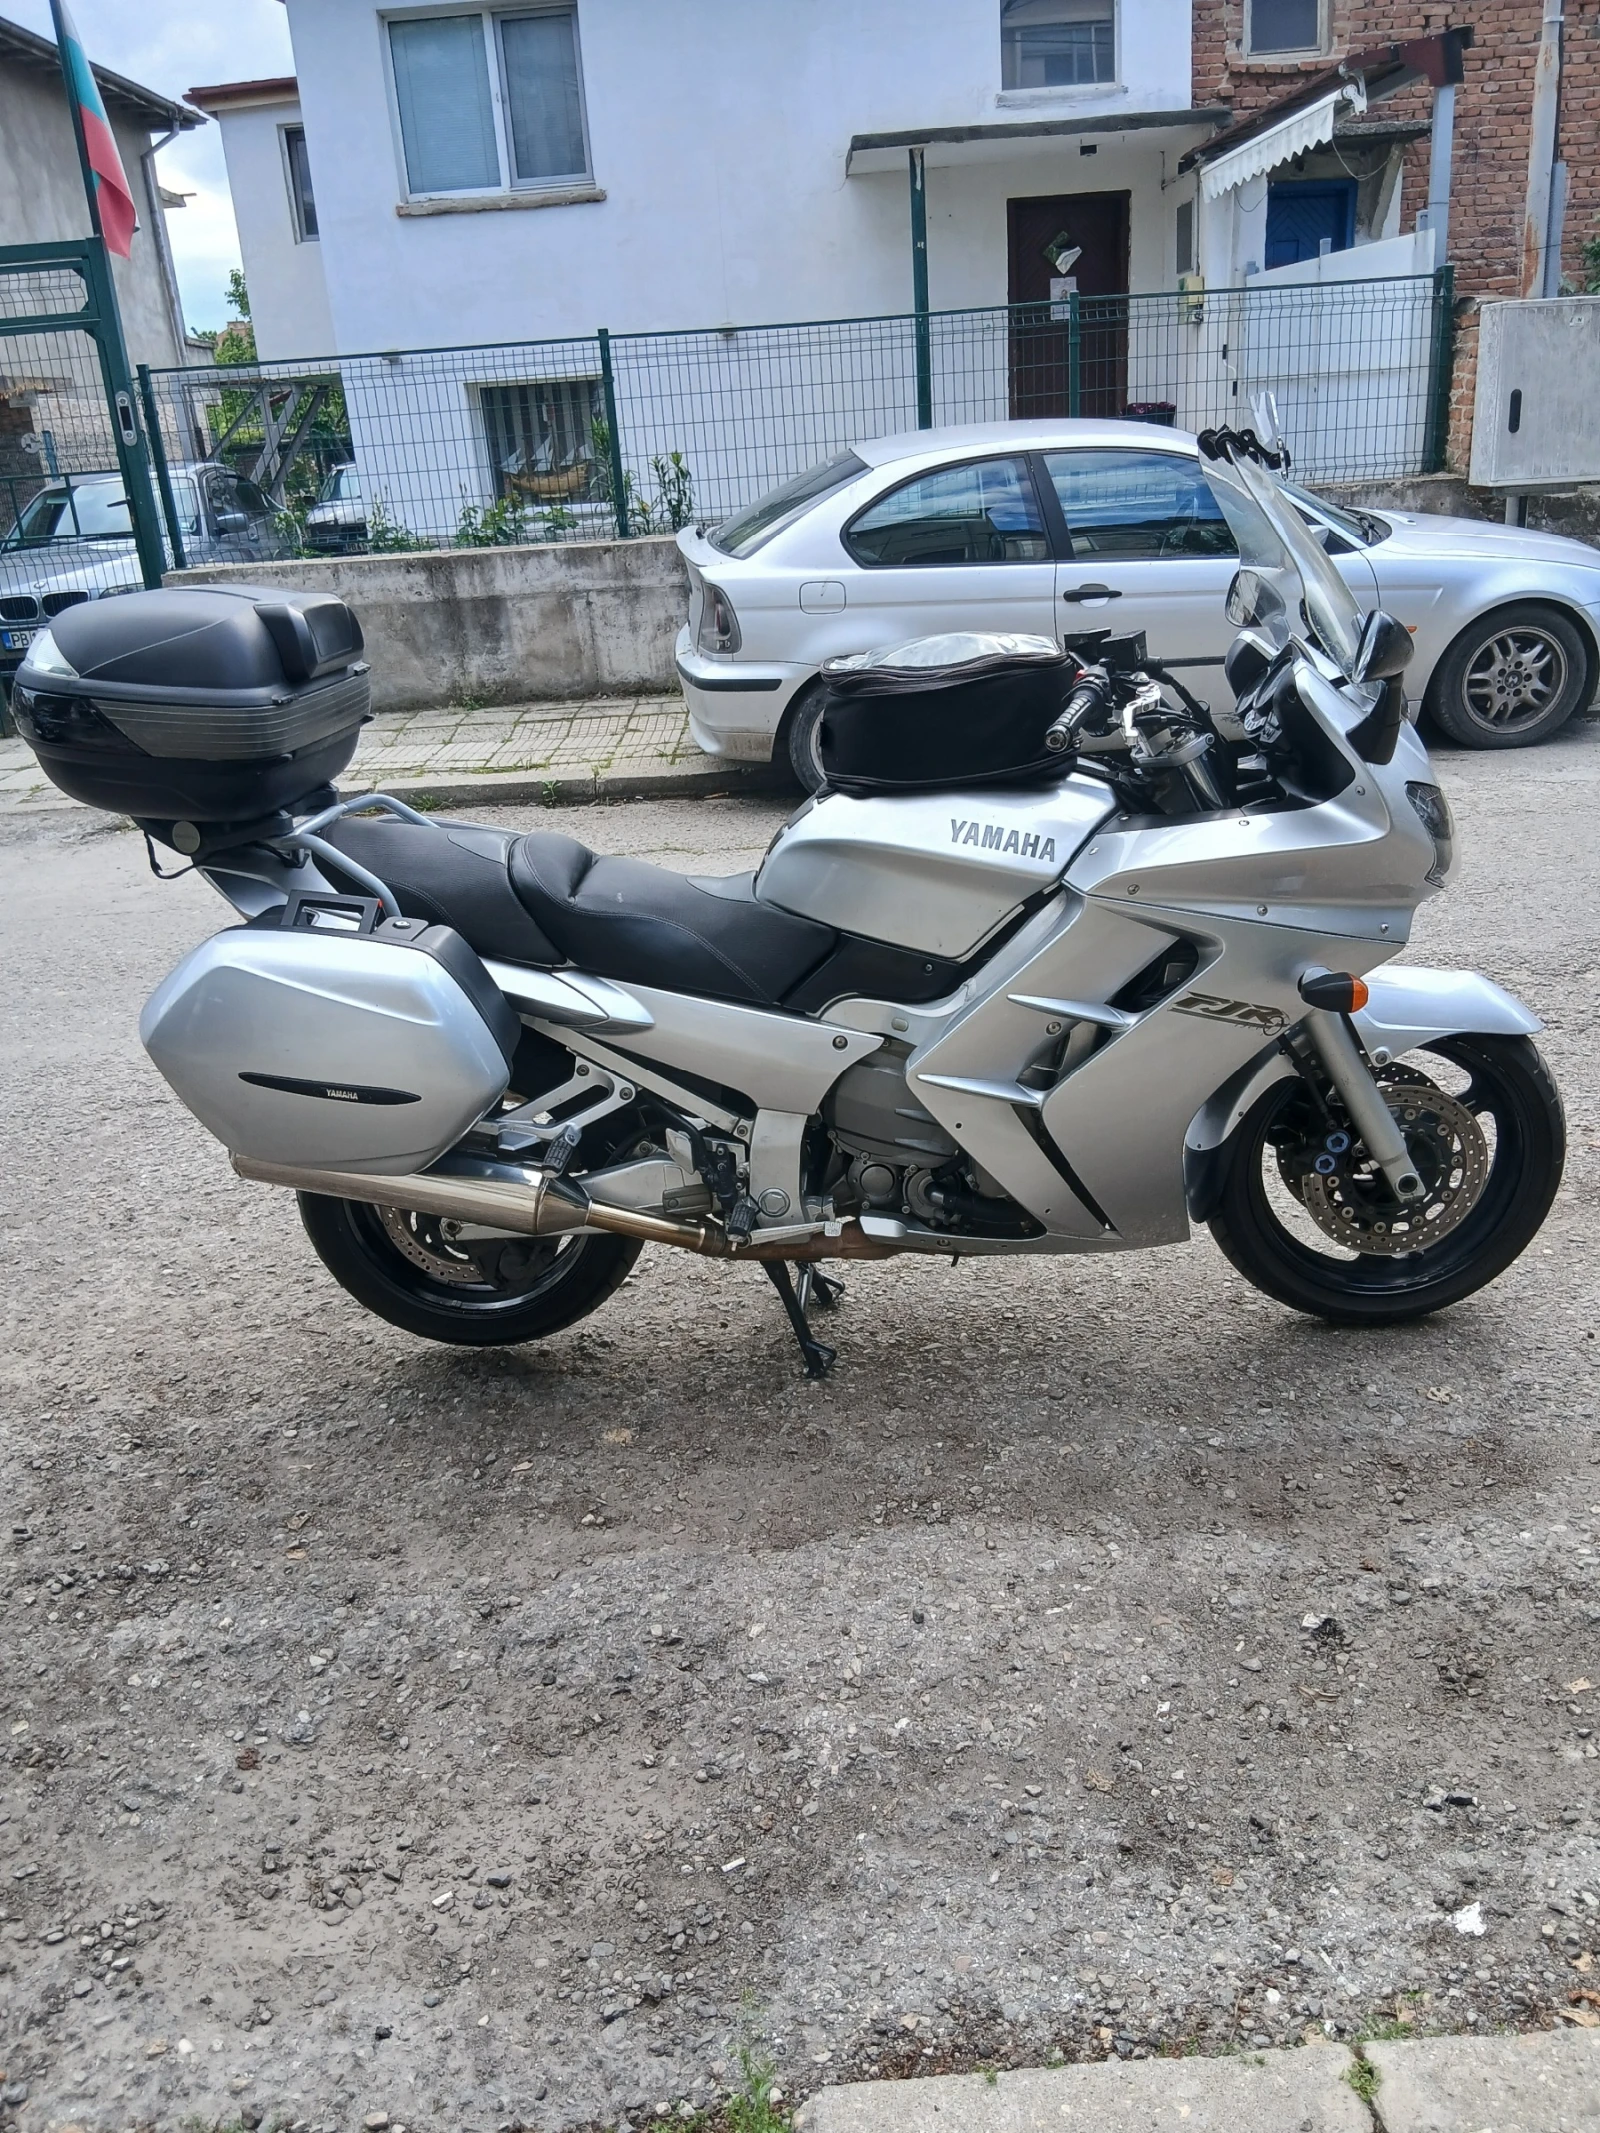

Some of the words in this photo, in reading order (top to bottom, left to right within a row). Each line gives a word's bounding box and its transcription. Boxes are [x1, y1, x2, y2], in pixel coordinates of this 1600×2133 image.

[951, 819, 1056, 863] YAMAHA
[1173, 991, 1285, 1025] FJR
[326, 1089, 358, 1100] YAMAHA
